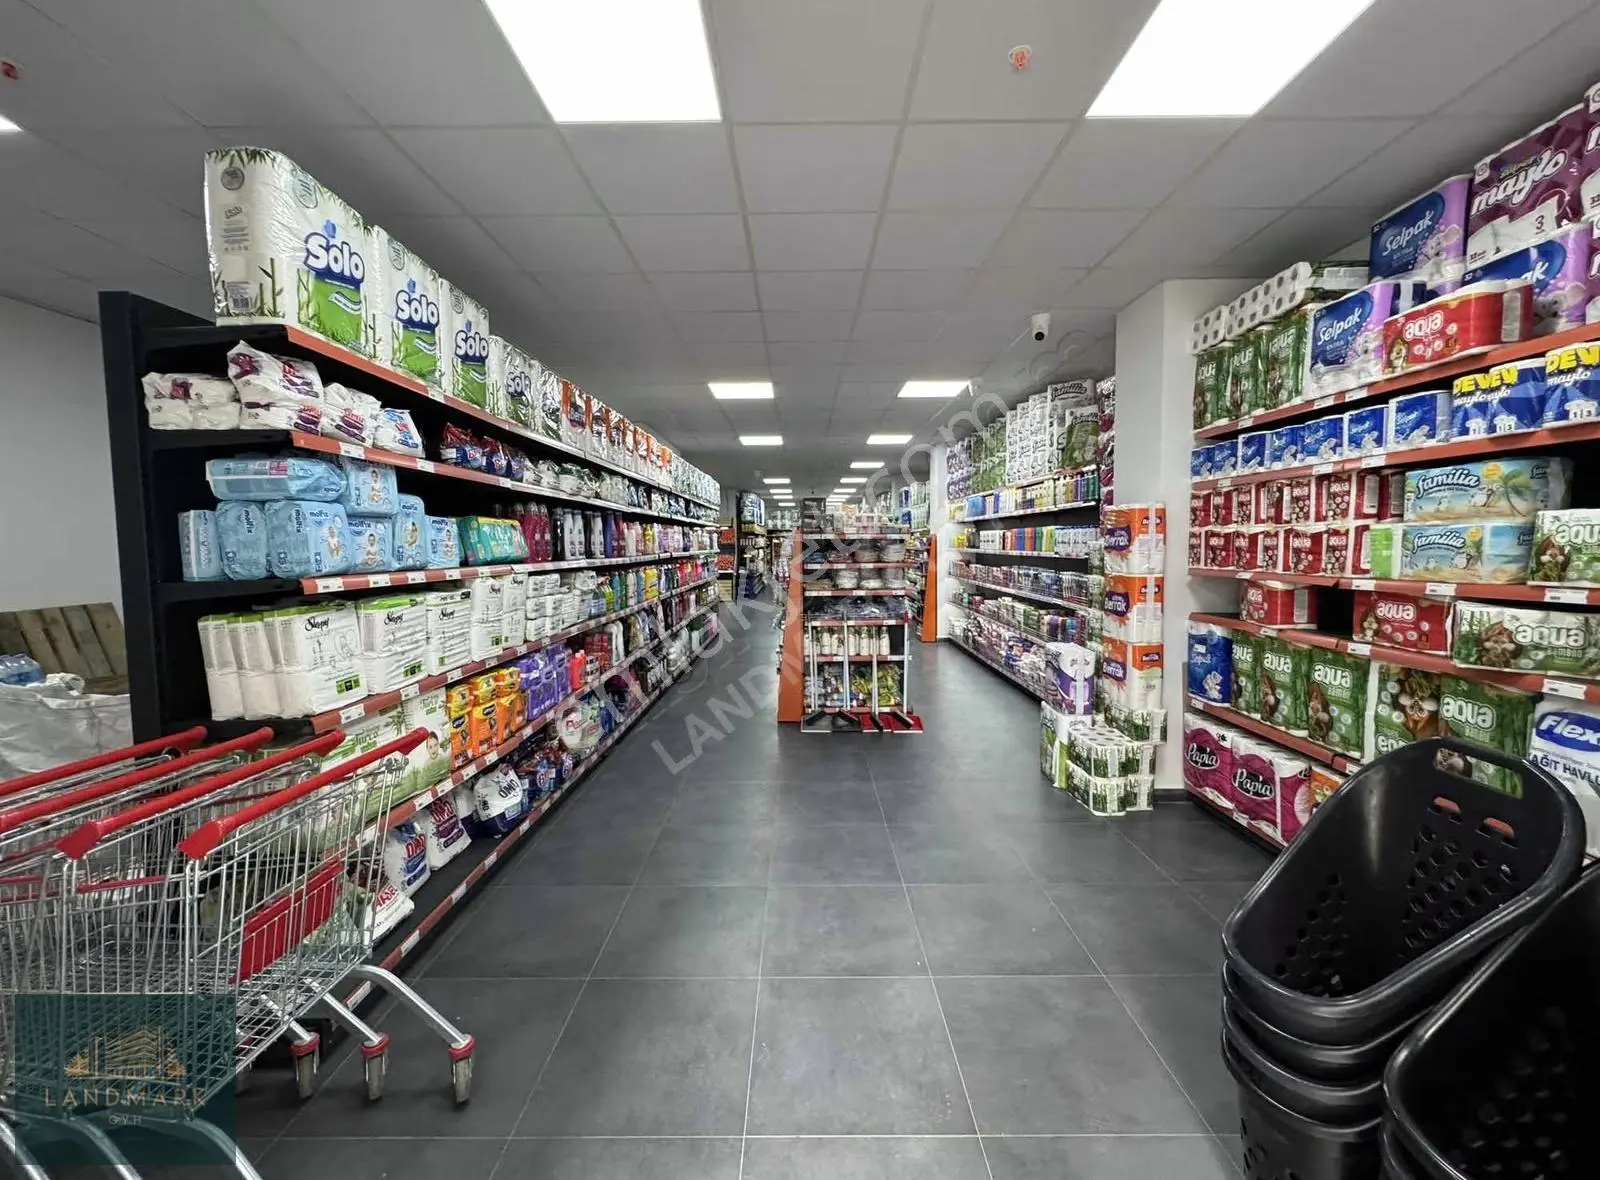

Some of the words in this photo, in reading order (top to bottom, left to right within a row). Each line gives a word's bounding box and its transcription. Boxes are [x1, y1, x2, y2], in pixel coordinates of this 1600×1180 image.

[1470, 148, 1567, 217] maylo
[1382, 210, 1434, 256] Selpak
[1535, 214, 1545, 231] 3
[304, 232, 364, 282] Solo
[395, 289, 439, 326] Solo
[1317, 307, 1362, 346] Selpak
[1404, 311, 1443, 341] aqua
[455, 330, 489, 359] Solo
[1547, 367, 1592, 388] maylo
[1416, 467, 1480, 499] familia
[1412, 530, 1466, 554] familia
[1555, 524, 1600, 546] aqu
[305, 615, 330, 632] Sleepy
[1376, 602, 1414, 621] aqua
[1515, 625, 1586, 648] aqua
[1263, 652, 1292, 673] aqua
[1314, 665, 1350, 689] aqua
[1442, 696, 1494, 730] aqua
[1187, 742, 1219, 767] Papia
[1235, 768, 1273, 796] Papia
